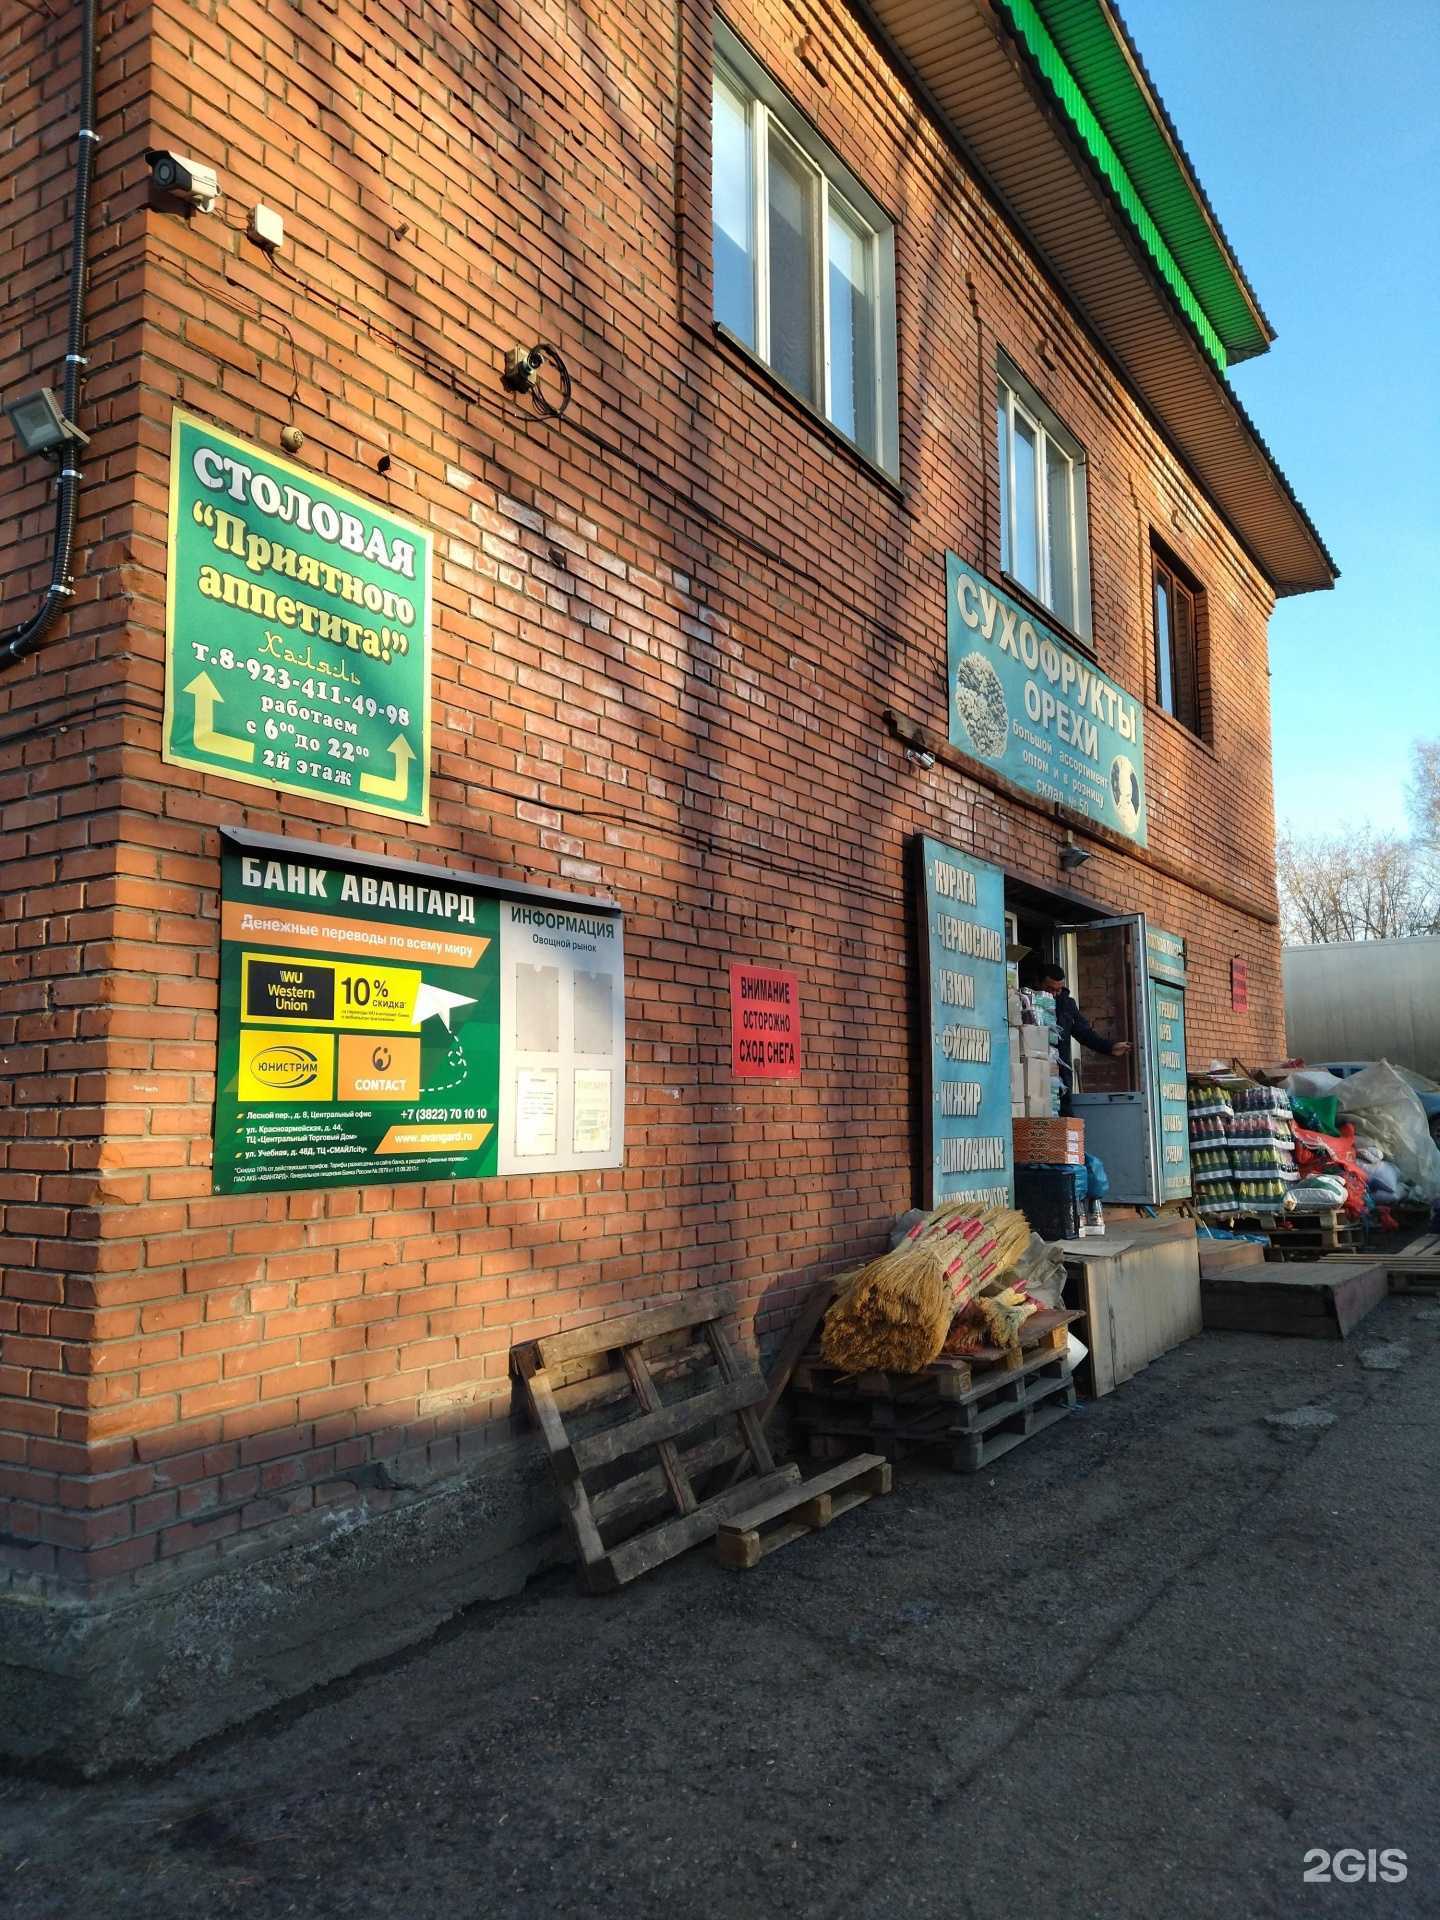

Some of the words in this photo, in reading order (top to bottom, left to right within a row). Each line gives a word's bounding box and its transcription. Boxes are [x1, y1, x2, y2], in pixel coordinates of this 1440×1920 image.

[193, 448, 416, 579] СТОЛОВАЯ
[957, 573, 1136, 744] СУХОФРУКТЫ
[260, 695, 358, 736] работаем
[1024, 679, 1097, 760] ОРЕХИ
[246, 720, 257, 734] с
[295, 733, 320, 751] до
[1013, 719, 1052, 755] большой
[262, 750, 290, 771] 2й
[296, 762, 352, 786] этаж
[1023, 750, 1048, 773] оптом
[1072, 780, 1104, 809] розницу
[241, 856, 328, 898] БАНК
[341, 875, 476, 924] АВАНГАРД
[935, 859, 976, 905] КУРАГА
[241, 914, 318, 936] Денежные
[322, 927, 386, 945] переводы
[389, 937, 405, 948] по
[406, 938, 443, 953] всему
[444, 944, 473, 957] миру
[511, 906, 614, 939] ИНФОРМАЦИЯ
[937, 913, 1001, 962] ЧЕРНОСЛИВ
[532, 934, 571, 948] Овощной
[572, 942, 597, 952] рынок
[268, 984, 315, 998] Western
[280, 970, 303, 983] WU
[741, 976, 790, 1004] ВНИМАНИЕ
[939, 969, 975, 1008] ИЗЮМ
[275, 998, 308, 1012] Union
[743, 1010, 790, 1032] ОСТОРОЖНО
[258, 1062, 318, 1072] ЮНИСТРИМ
[740, 1040, 765, 1068] СХОД
[767, 1042, 795, 1064] СНЕГА
[355, 1079, 407, 1091] CONTACT
[246, 1111, 274, 1119] Лесной
[310, 1110, 354, 1118] Центральный
[355, 1110, 372, 1119] офис
[400, 1109, 413, 1119] +7
[416, 1108, 448, 1121] (3822)
[450, 1109, 461, 1119] 70
[464, 1109, 474, 1119] 10
[477, 1108, 487, 1119] 10
[941, 1137, 1004, 1172] ШИПОВНИК
